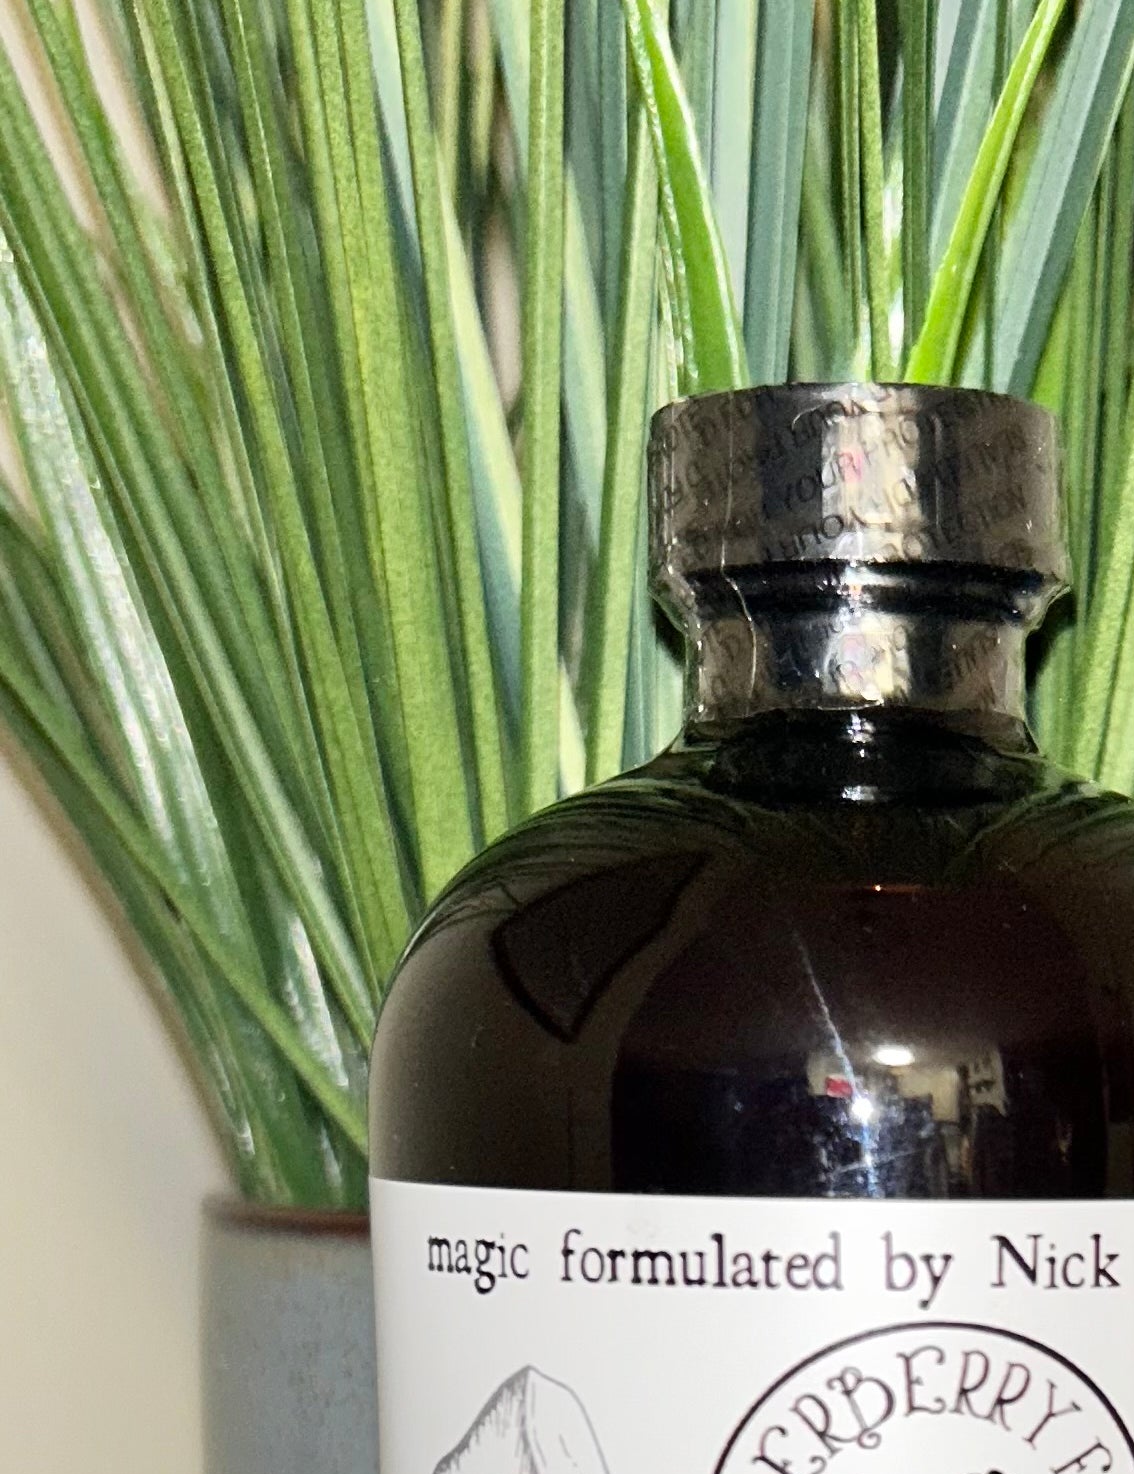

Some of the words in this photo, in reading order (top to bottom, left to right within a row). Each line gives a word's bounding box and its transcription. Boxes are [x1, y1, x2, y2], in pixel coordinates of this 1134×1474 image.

[426, 1230, 530, 1296] magic
[558, 1227, 843, 1291] formulated
[882, 1231, 955, 1311] by
[990, 1231, 1122, 1290] Nick
